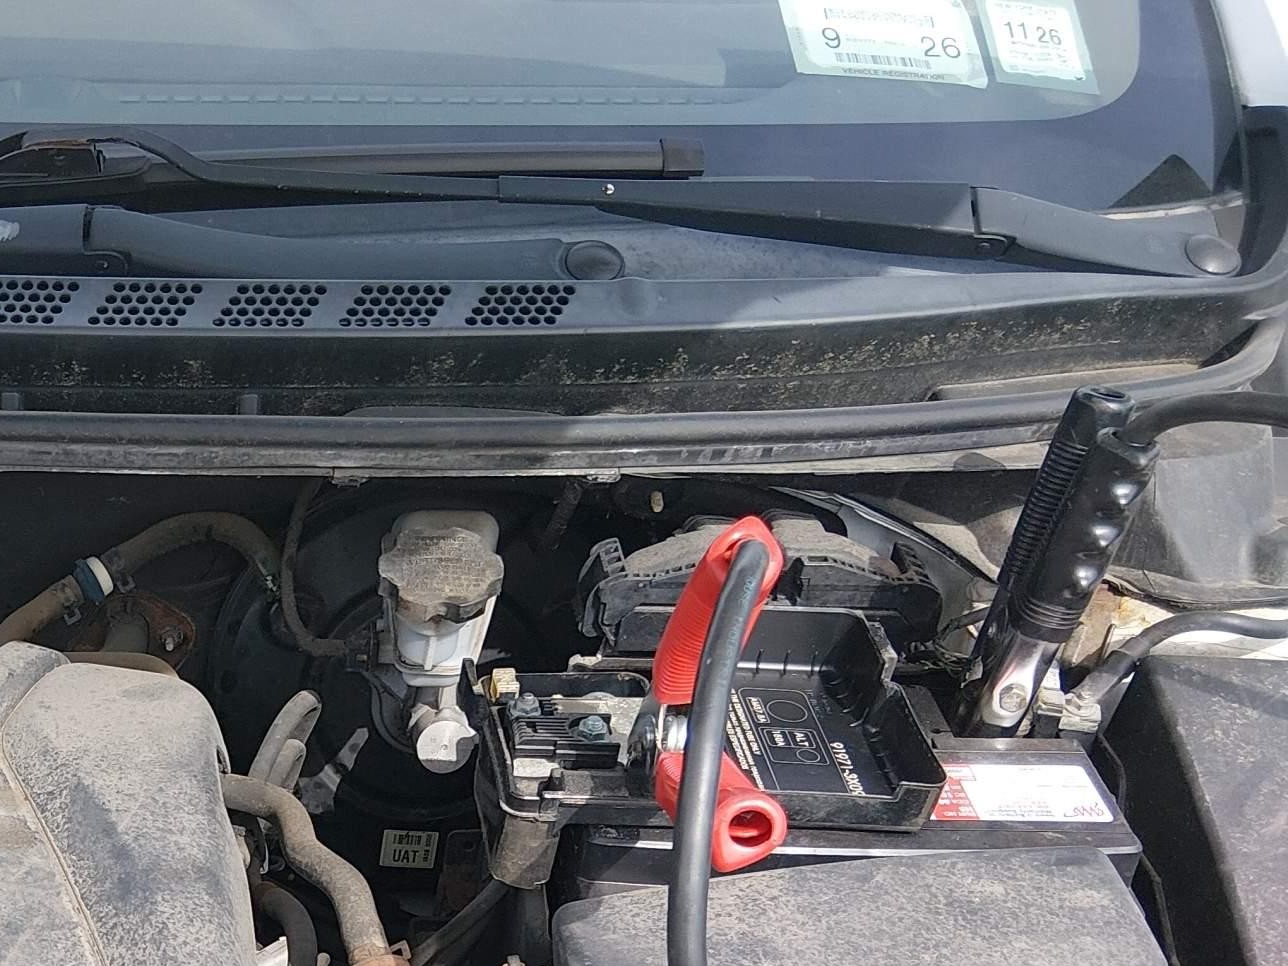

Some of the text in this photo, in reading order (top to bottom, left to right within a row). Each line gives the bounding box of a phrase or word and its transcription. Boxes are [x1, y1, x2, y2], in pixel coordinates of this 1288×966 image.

[822, 27, 961, 59] 9 26
[1004, 21, 1062, 46] 11 26
[793, 732, 810, 747] ALT
[393, 849, 419, 863] UAT
